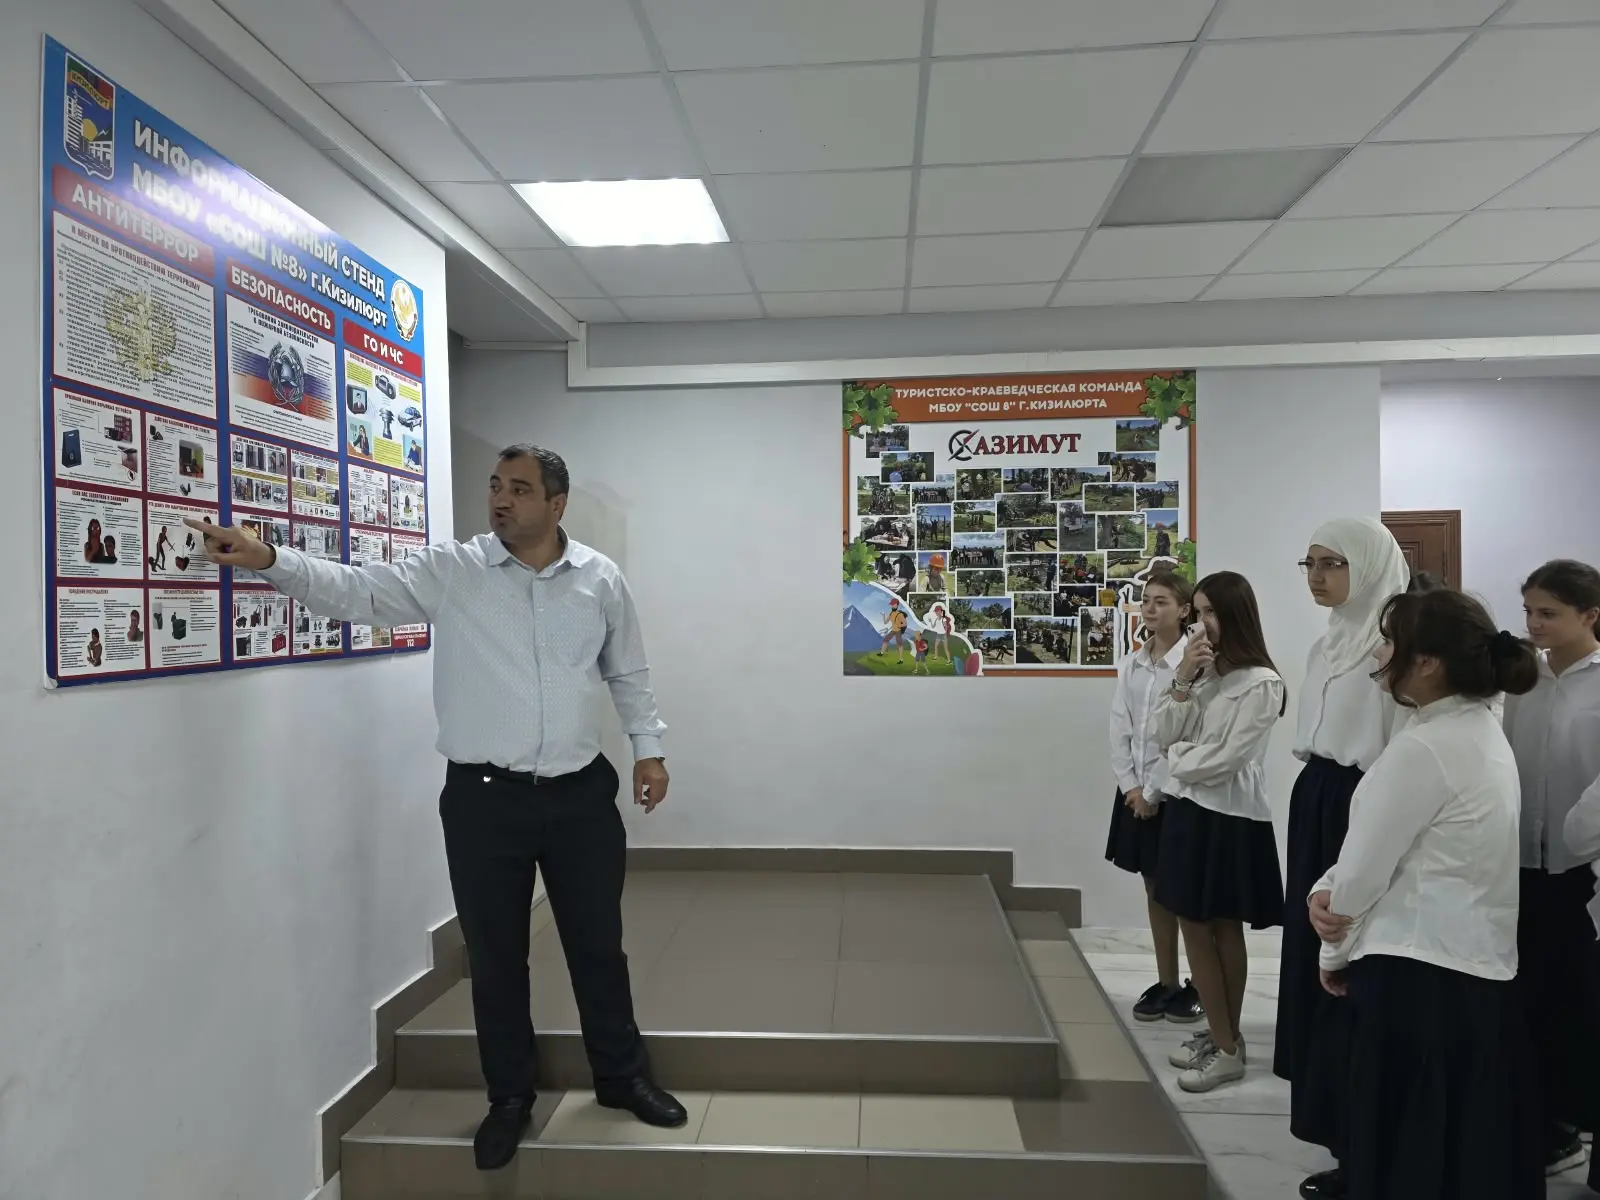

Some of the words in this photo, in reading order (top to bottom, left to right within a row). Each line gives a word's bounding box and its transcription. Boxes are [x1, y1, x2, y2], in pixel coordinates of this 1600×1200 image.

[71, 183, 199, 262] АНТИТЕРРОР
[133, 162, 202, 223] МБОУ
[206, 212, 266, 262] «СОШ
[271, 243, 308, 282] №8»
[311, 271, 388, 328] г.Кизилюрт
[231, 265, 331, 330] БЕЗОПАСНОСТЬ
[341, 255, 386, 302] СТЕНД
[363, 334, 379, 352] ГО
[380, 342, 388, 358] И
[390, 347, 404, 365] ЧС
[895, 383, 1076, 398] ТУРИСТСКО-КРАЕВЕДЧЕСКАЯ
[1079, 381, 1142, 393] КОМАНДА
[929, 403, 961, 413] МБОУ
[965, 402, 1000, 412] "СОШ
[1003, 401, 1016, 411] 8"
[1019, 398, 1107, 411] Г.КИЗИЛЮРТА
[972, 433, 1082, 456] АЗИМУТ
